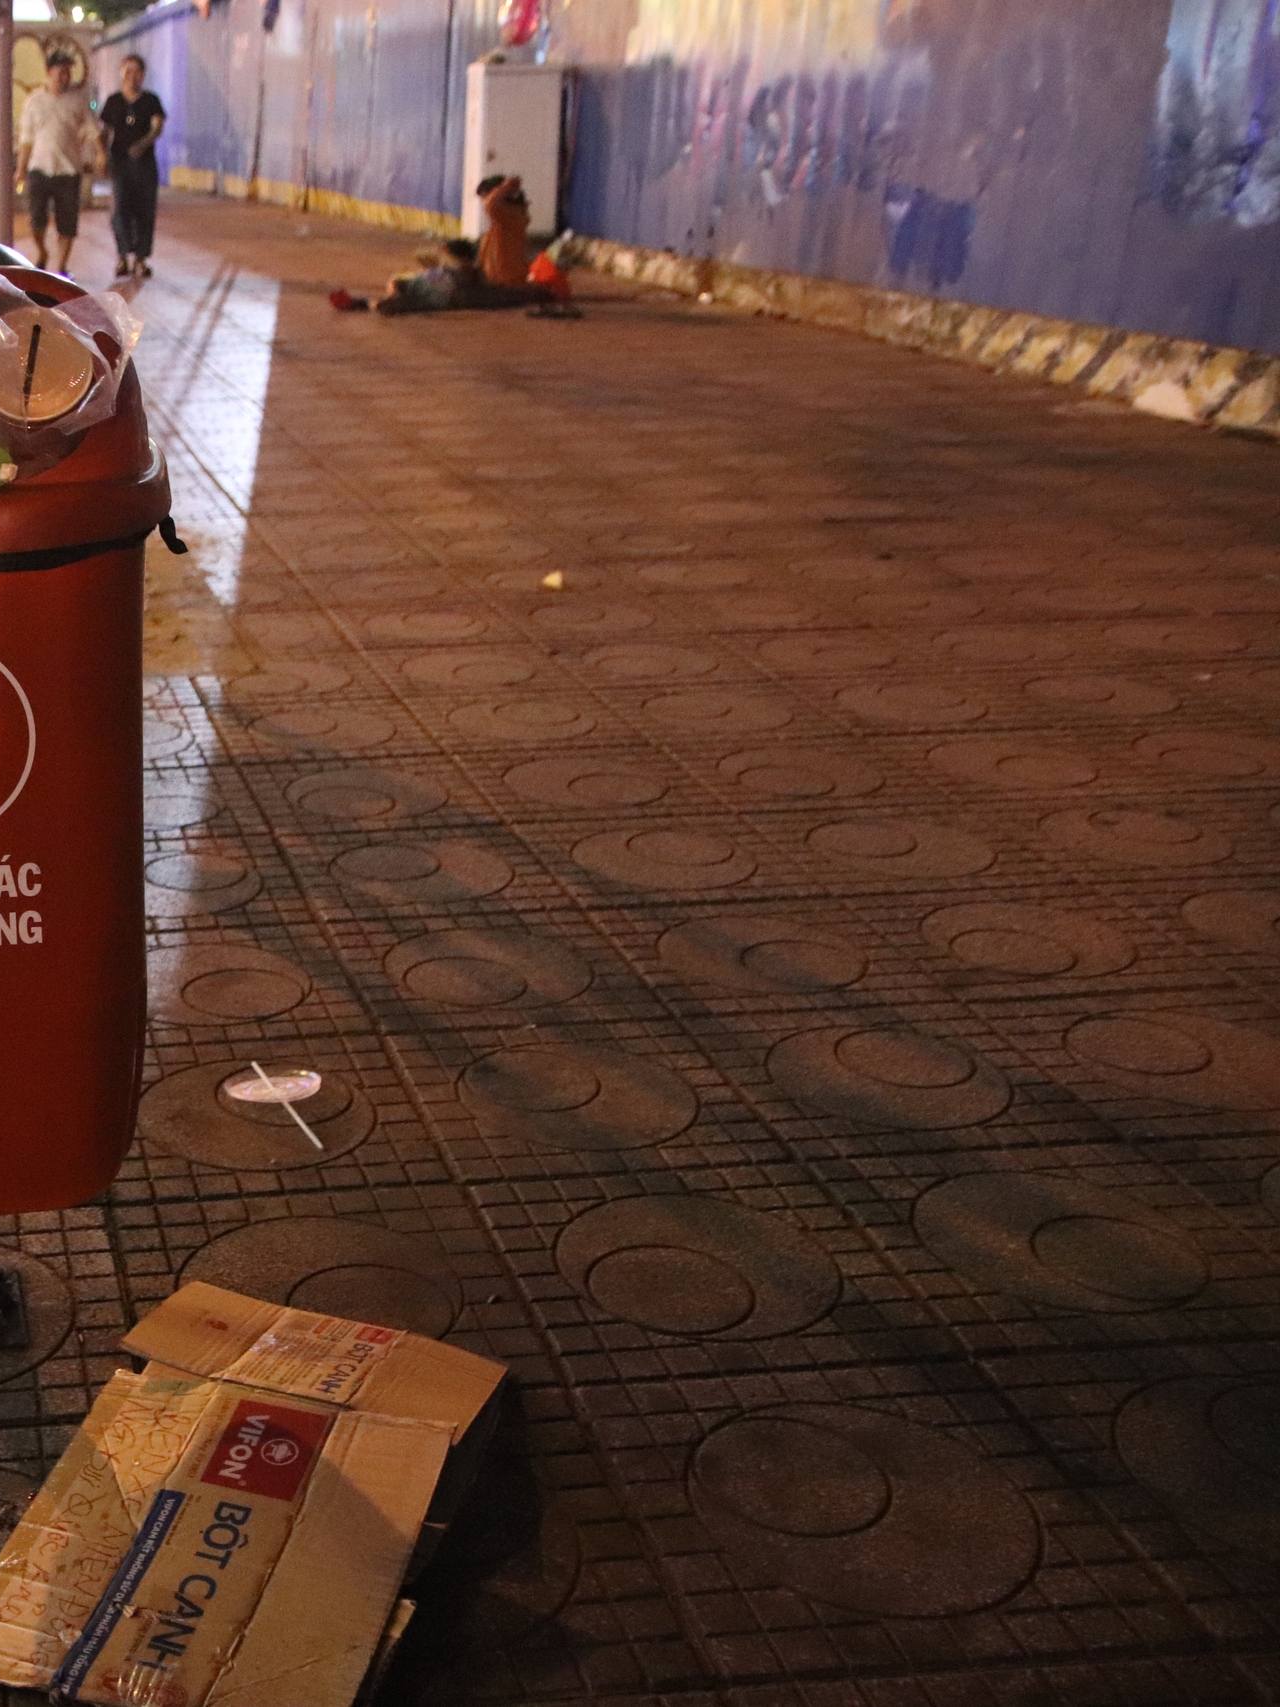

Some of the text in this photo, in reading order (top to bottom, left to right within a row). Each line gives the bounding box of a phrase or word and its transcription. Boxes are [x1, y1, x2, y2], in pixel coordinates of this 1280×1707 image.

[218, 1415, 271, 1480] VIFON
[148, 1521, 163, 1540] CAM
[157, 1499, 176, 1522] VIFON
[195, 1501, 253, 1570] BỘT
[140, 1571, 218, 1672] CANH
